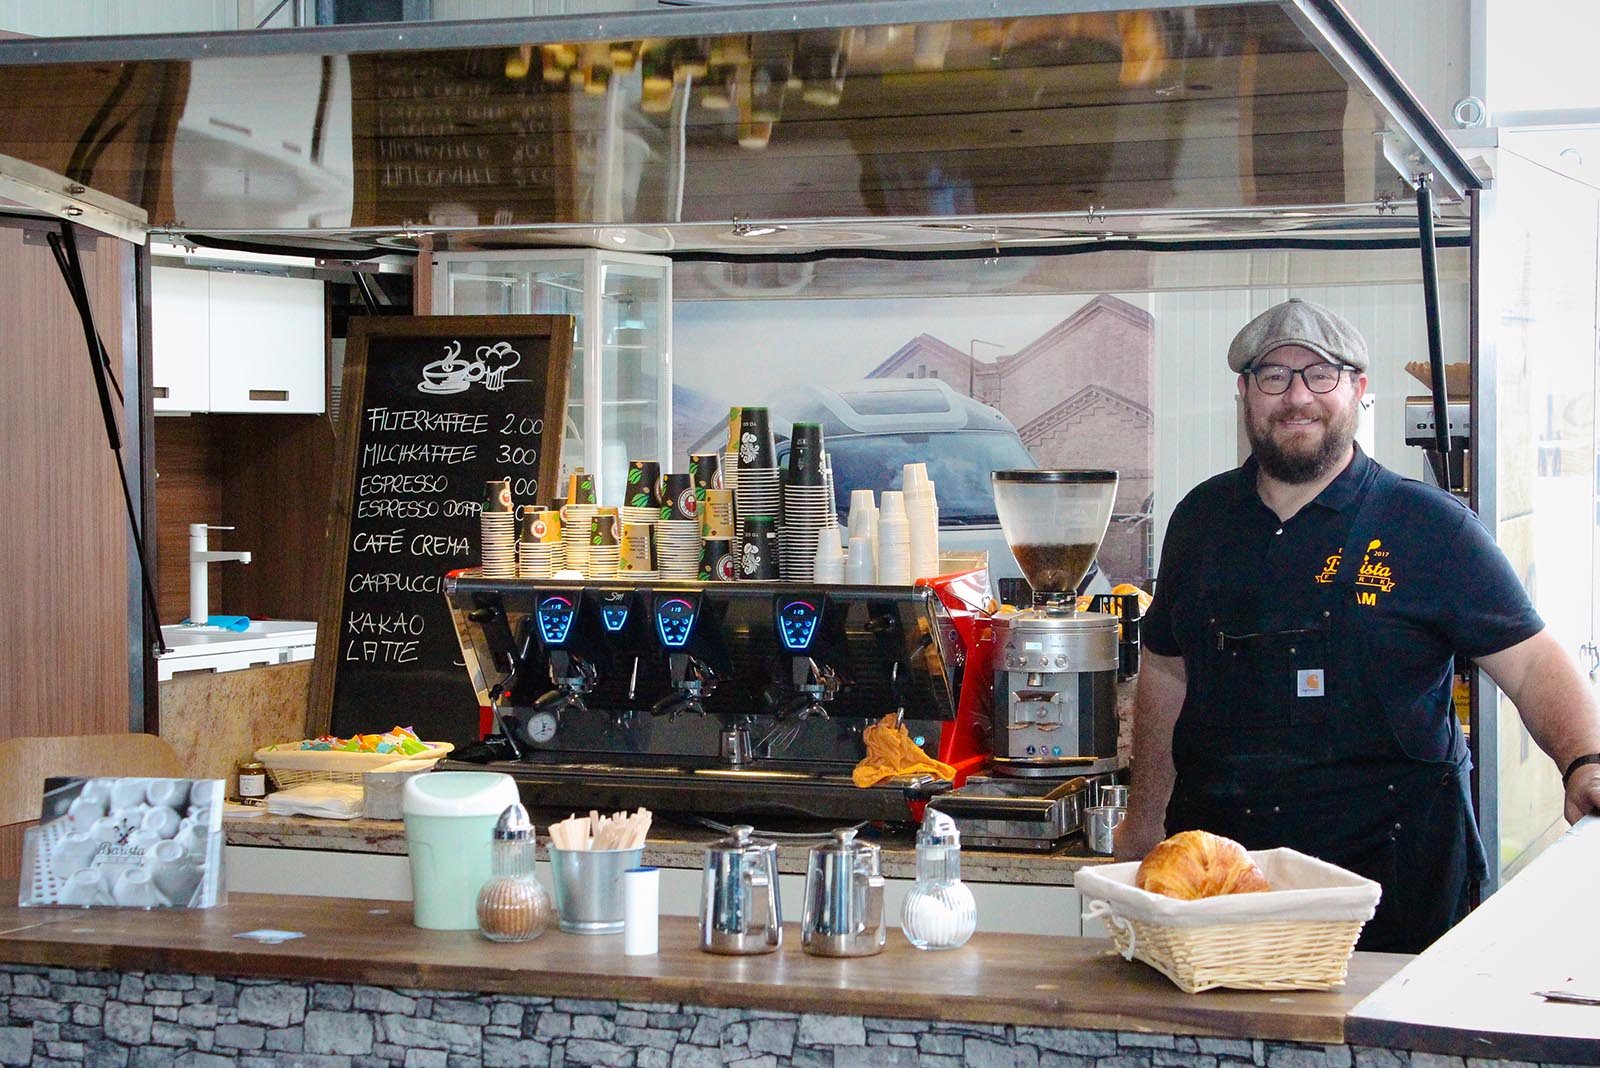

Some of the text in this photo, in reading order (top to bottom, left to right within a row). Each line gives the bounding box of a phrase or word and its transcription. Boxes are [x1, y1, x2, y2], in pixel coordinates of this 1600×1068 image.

[367, 408, 544, 435] FILTERKAFFEE 2.00
[362, 443, 537, 468] MILCHKAFFEE 3.00
[360, 474, 449, 496] ESPRESSO
[357, 499, 484, 519] ESPRESSO DOPPI
[353, 528, 470, 556] CAFÉ CREMA
[349, 573, 442, 594] CAPPUCCI
[348, 611, 425, 635] KAKAO
[346, 640, 420, 663] LATTE
